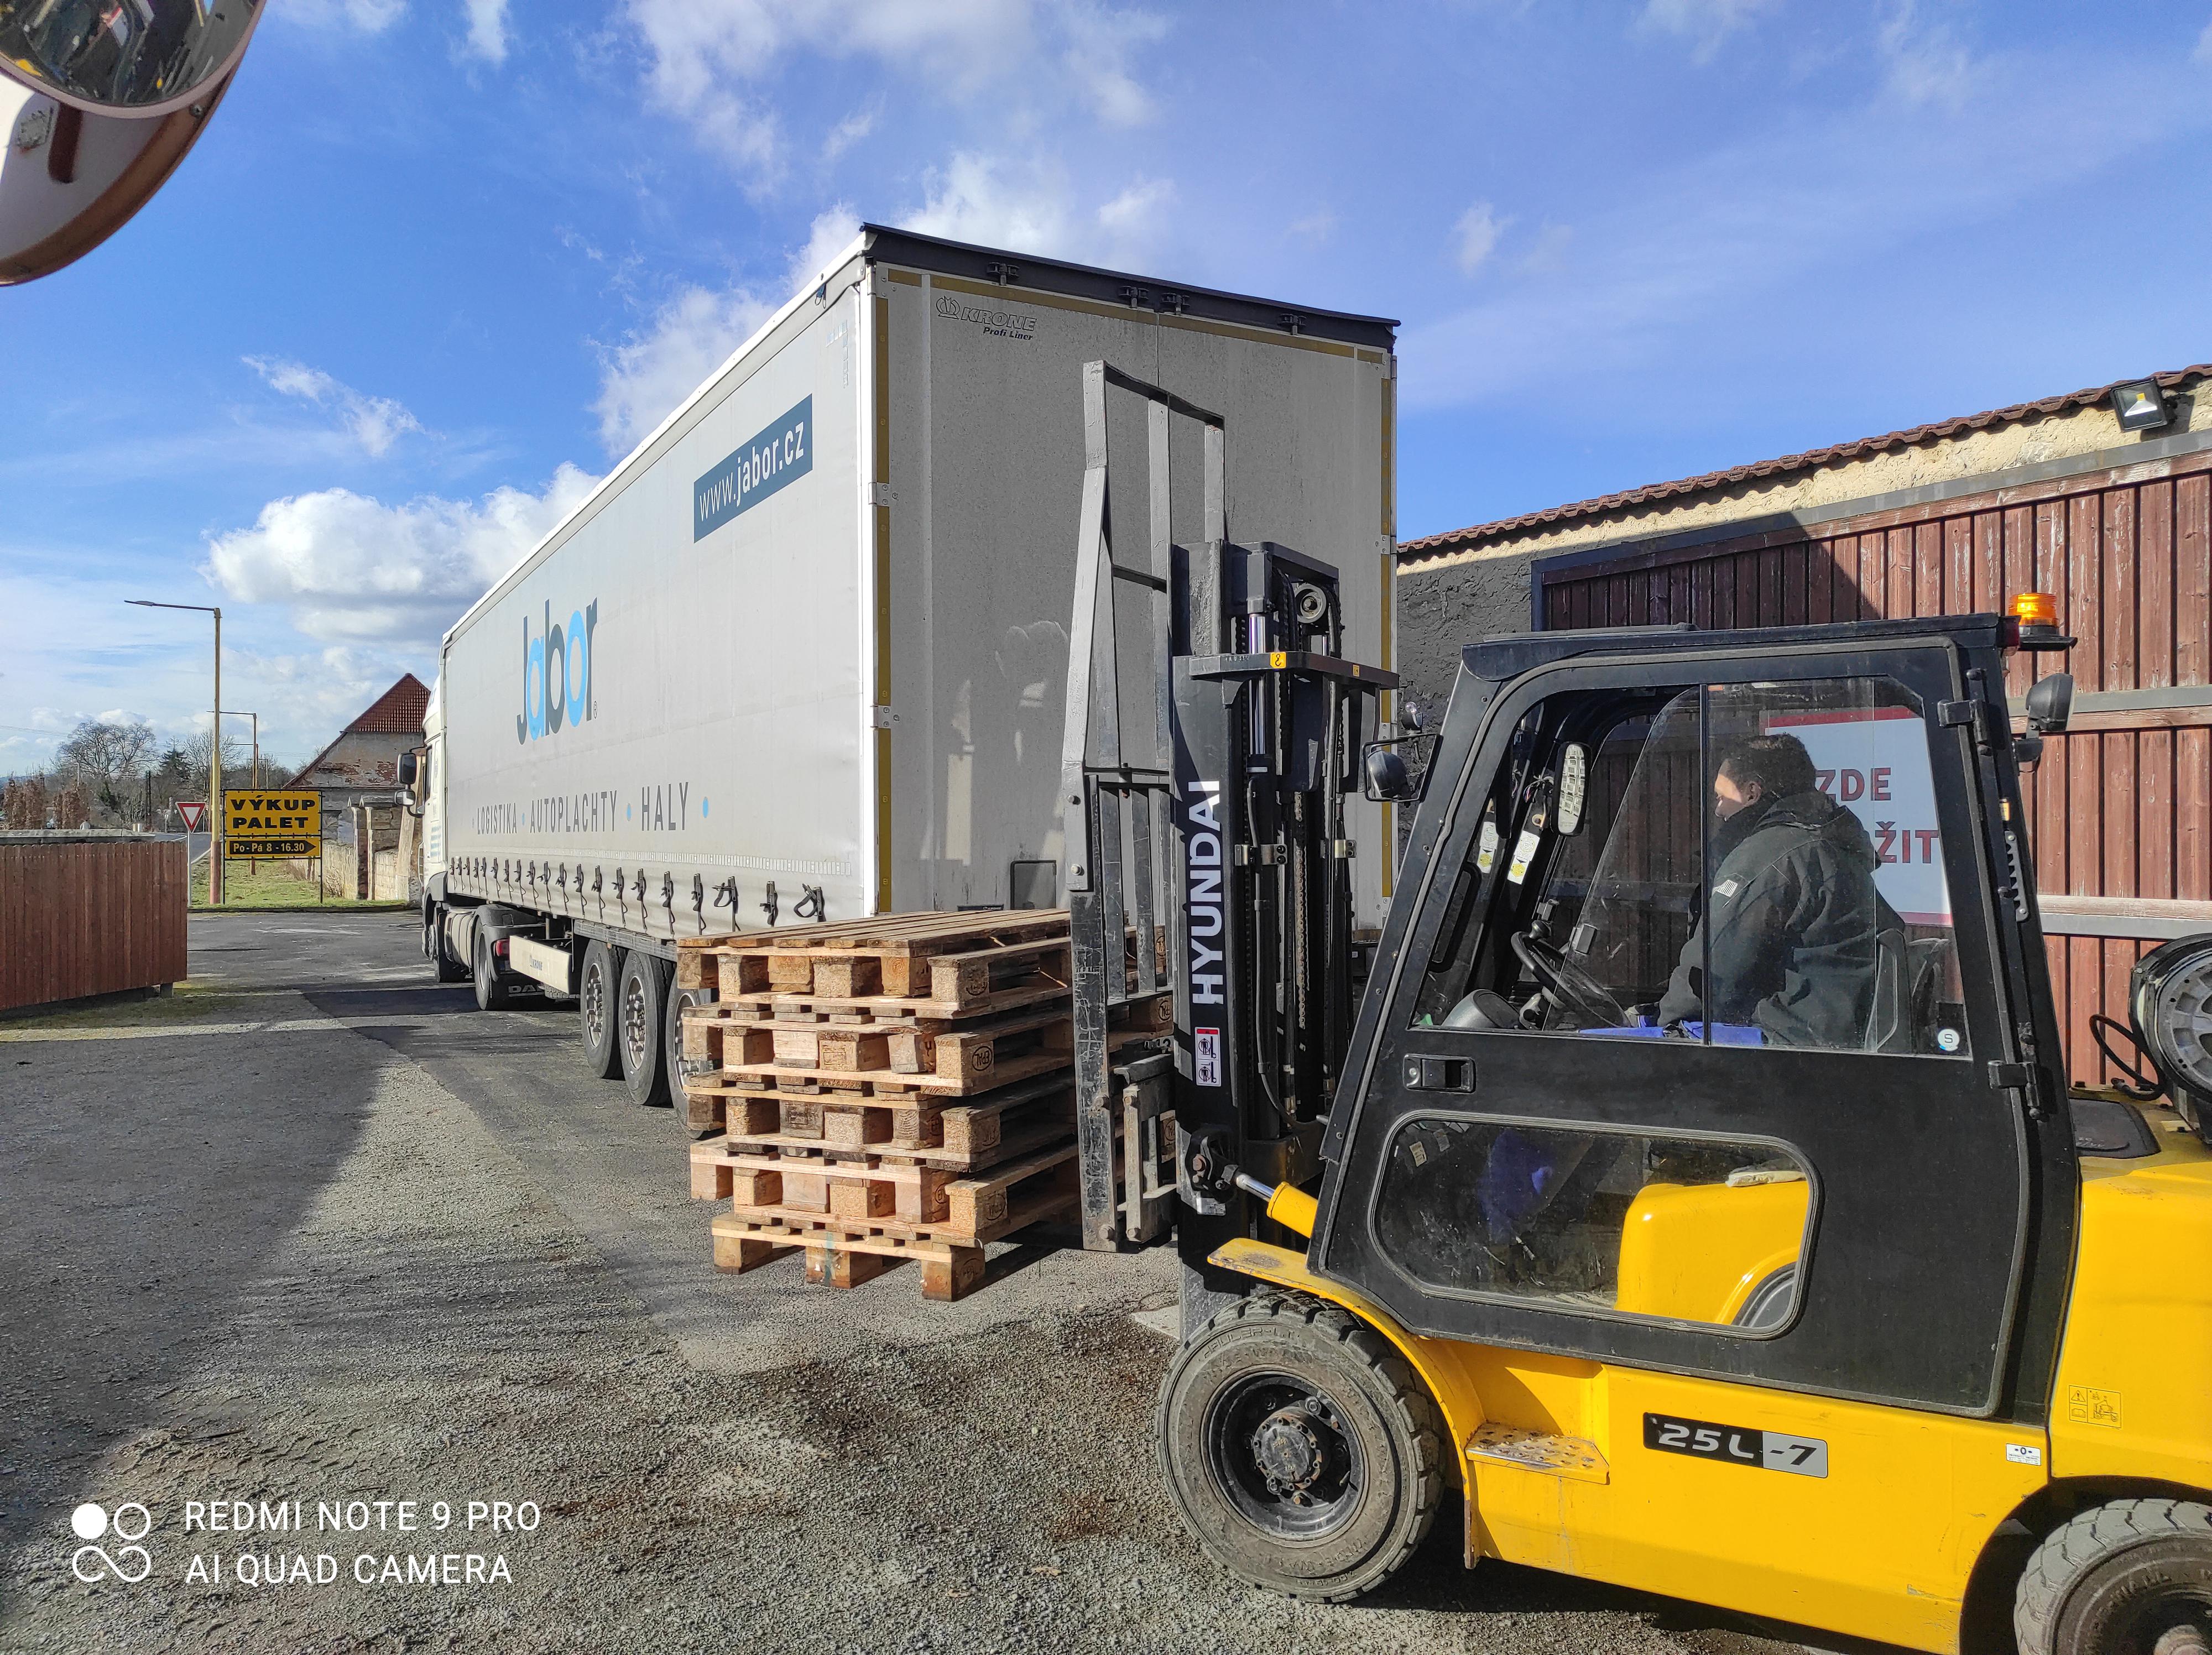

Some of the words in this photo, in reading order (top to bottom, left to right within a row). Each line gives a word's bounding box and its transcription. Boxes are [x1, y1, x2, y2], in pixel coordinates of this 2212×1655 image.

[961, 307, 1037, 331] KRONE
[983, 327, 1007, 337] Profi
[1009, 330, 1034, 341] Liner
[700, 421, 804, 522] www.jabor.cz
[1815, 767, 1891, 802] ZDE
[230, 795, 315, 811] VÝKUP
[477, 802, 517, 835] LOGISTIKA
[530, 790, 617, 834] AUTOPLACHTY
[641, 782, 688, 831] HALY
[233, 817, 309, 829] PALET
[266, 843, 272, 852] 8
[1188, 781, 1224, 1005] HYUNDAI
[509, 984, 544, 993] DA
